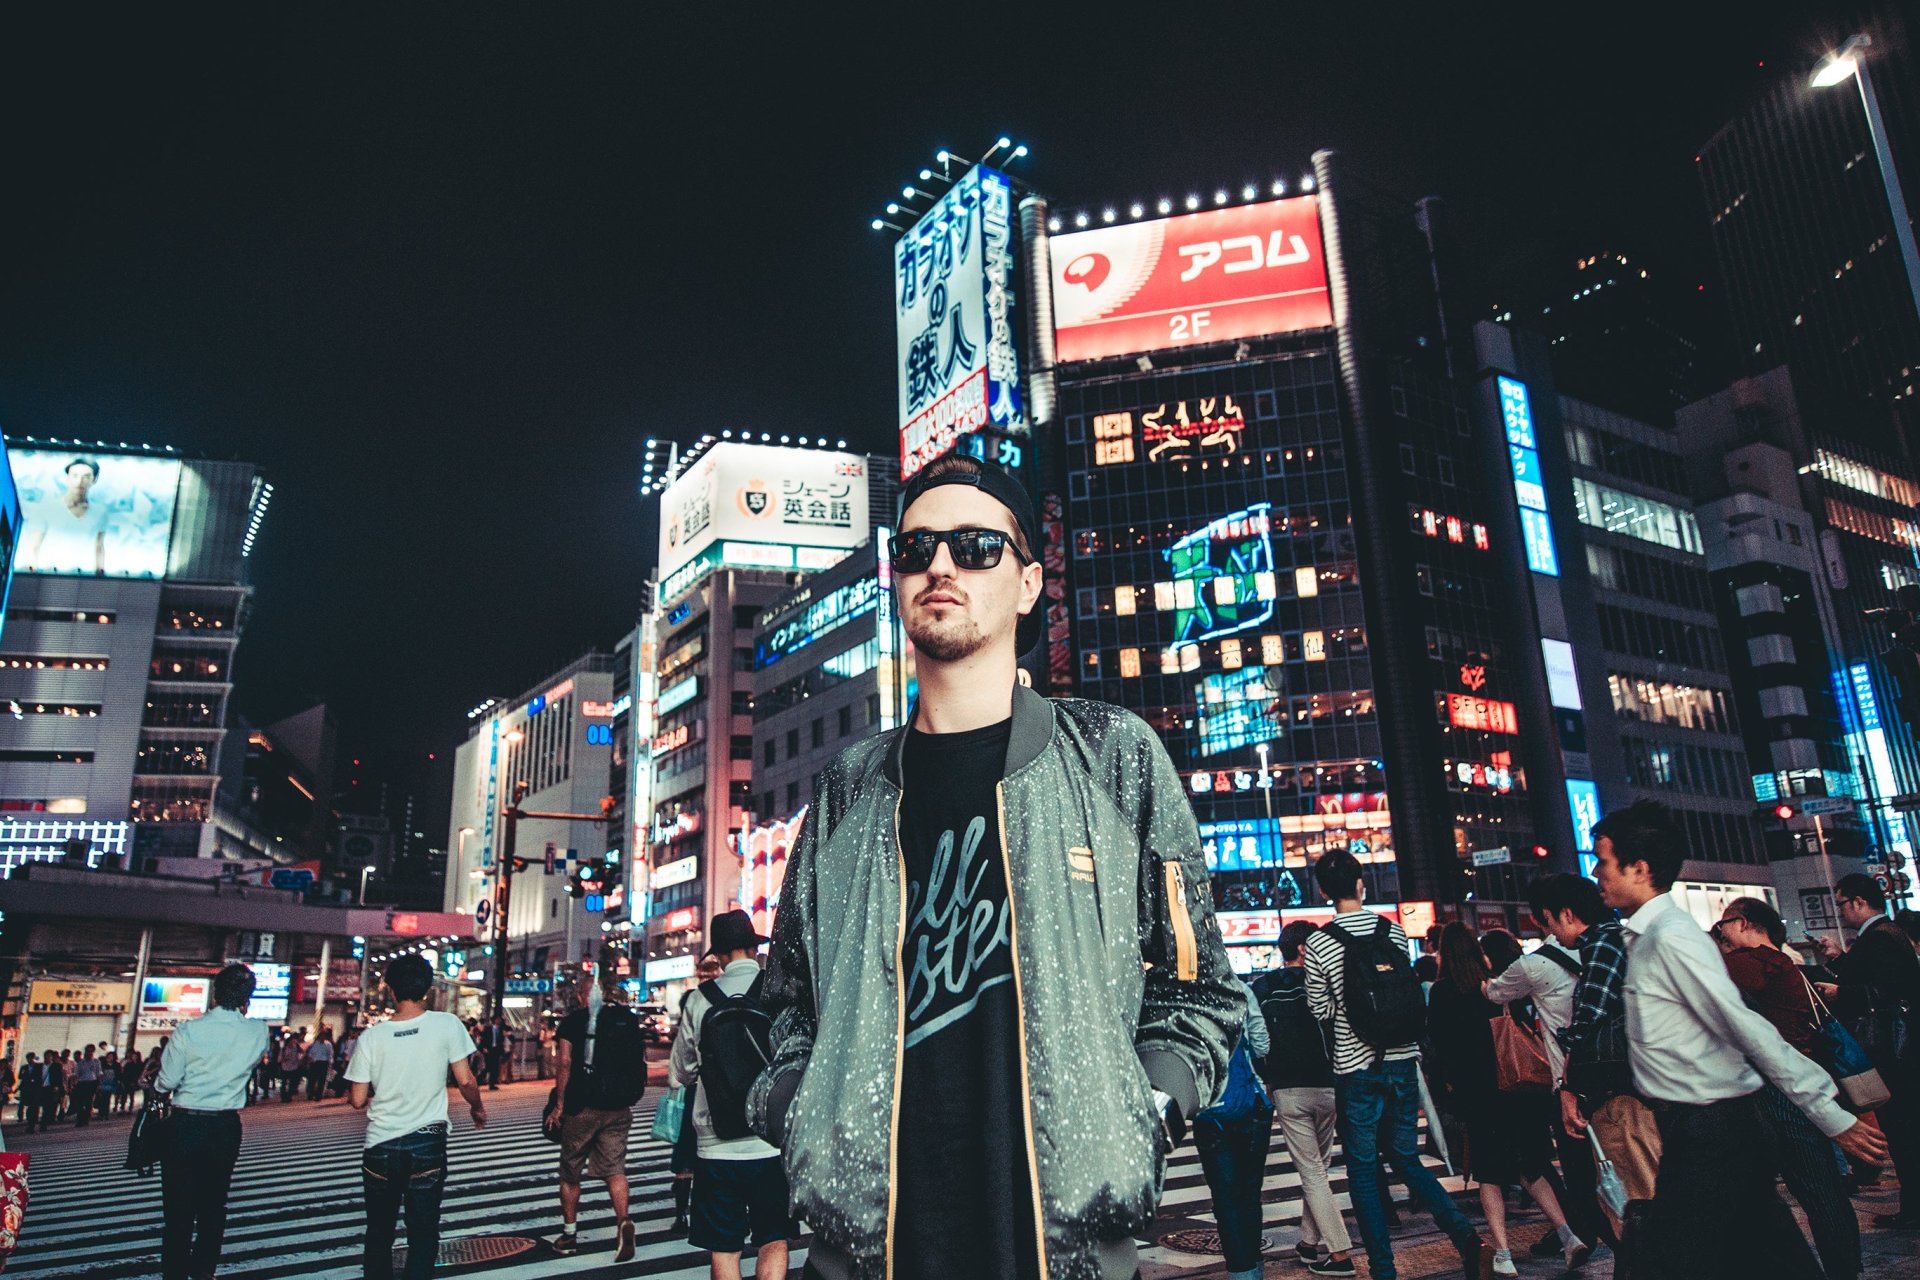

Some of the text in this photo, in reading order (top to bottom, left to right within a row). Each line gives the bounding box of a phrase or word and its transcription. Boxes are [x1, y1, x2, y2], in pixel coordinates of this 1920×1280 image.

[1178, 229, 1311, 283] アコム
[1169, 311, 1211, 340] 2F
[783, 479, 850, 499] シェーン
[784, 498, 851, 521] 英会話
[1071, 870, 1095, 883] RAW
[1231, 917, 1280, 936] アコム
